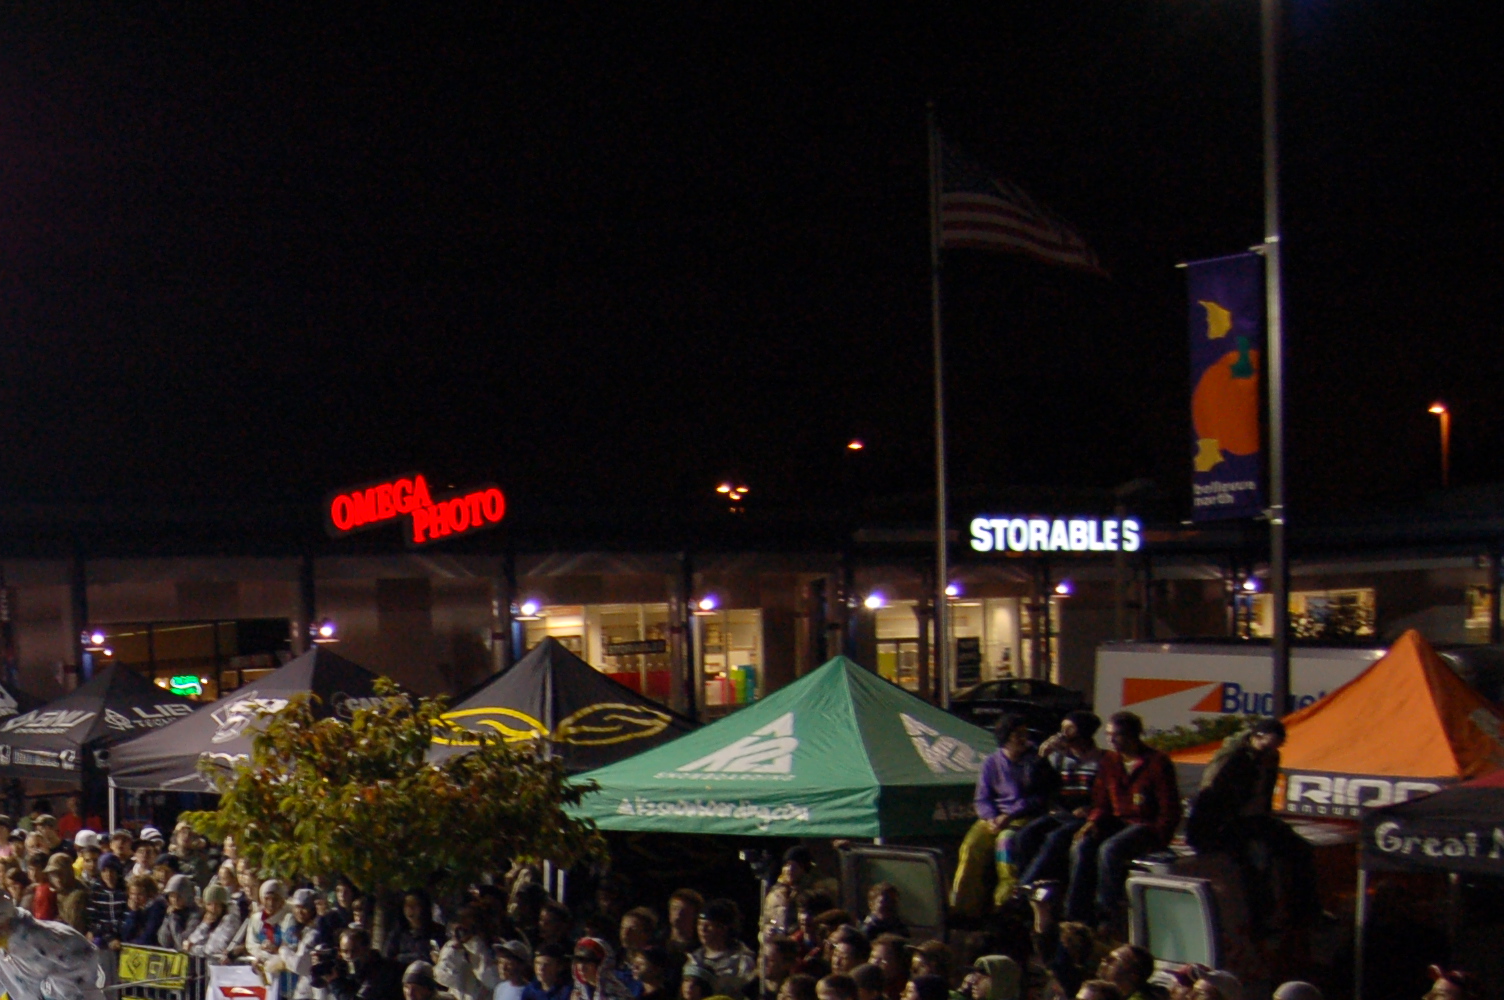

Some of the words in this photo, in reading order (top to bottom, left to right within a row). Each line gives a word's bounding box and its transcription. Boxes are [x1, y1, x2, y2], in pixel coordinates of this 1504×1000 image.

[331, 475, 432, 531] OMEGA
[412, 488, 505, 543] PHOTO
[970, 517, 1140, 552] STORABLES
[1374, 821, 1479, 859] Great
